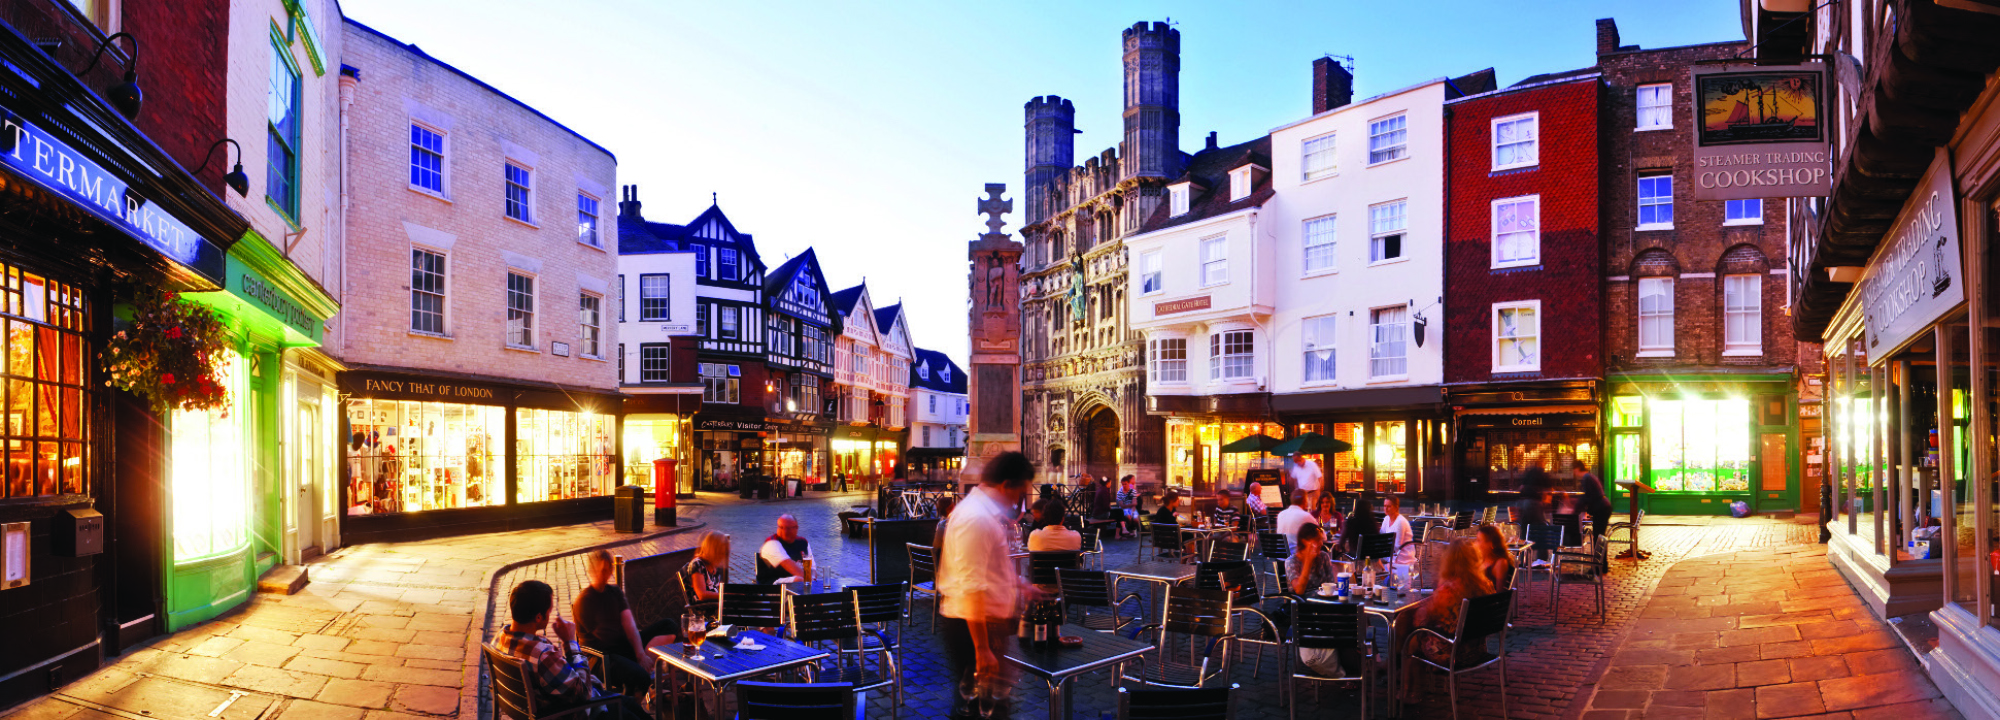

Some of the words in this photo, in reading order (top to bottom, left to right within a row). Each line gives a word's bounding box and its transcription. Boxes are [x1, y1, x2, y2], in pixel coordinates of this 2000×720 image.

[1700, 153, 1761, 168] STEAMER
[1765, 151, 1825, 165] TRADING
[1700, 167, 1825, 190] COOKSHOP
[1865, 259, 1896, 310] STEAMER
[1895, 190, 1942, 274] TRADING
[242, 274, 291, 323] canterbury
[1877, 260, 1926, 332] COOKSHOP
[366, 378, 405, 393] FANCY
[408, 382, 435, 395] THAT
[438, 384, 451, 396] OF
[454, 386, 493, 399] LONDON
[737, 421, 762, 429] Visitor
[1511, 417, 1543, 426] Cornell
